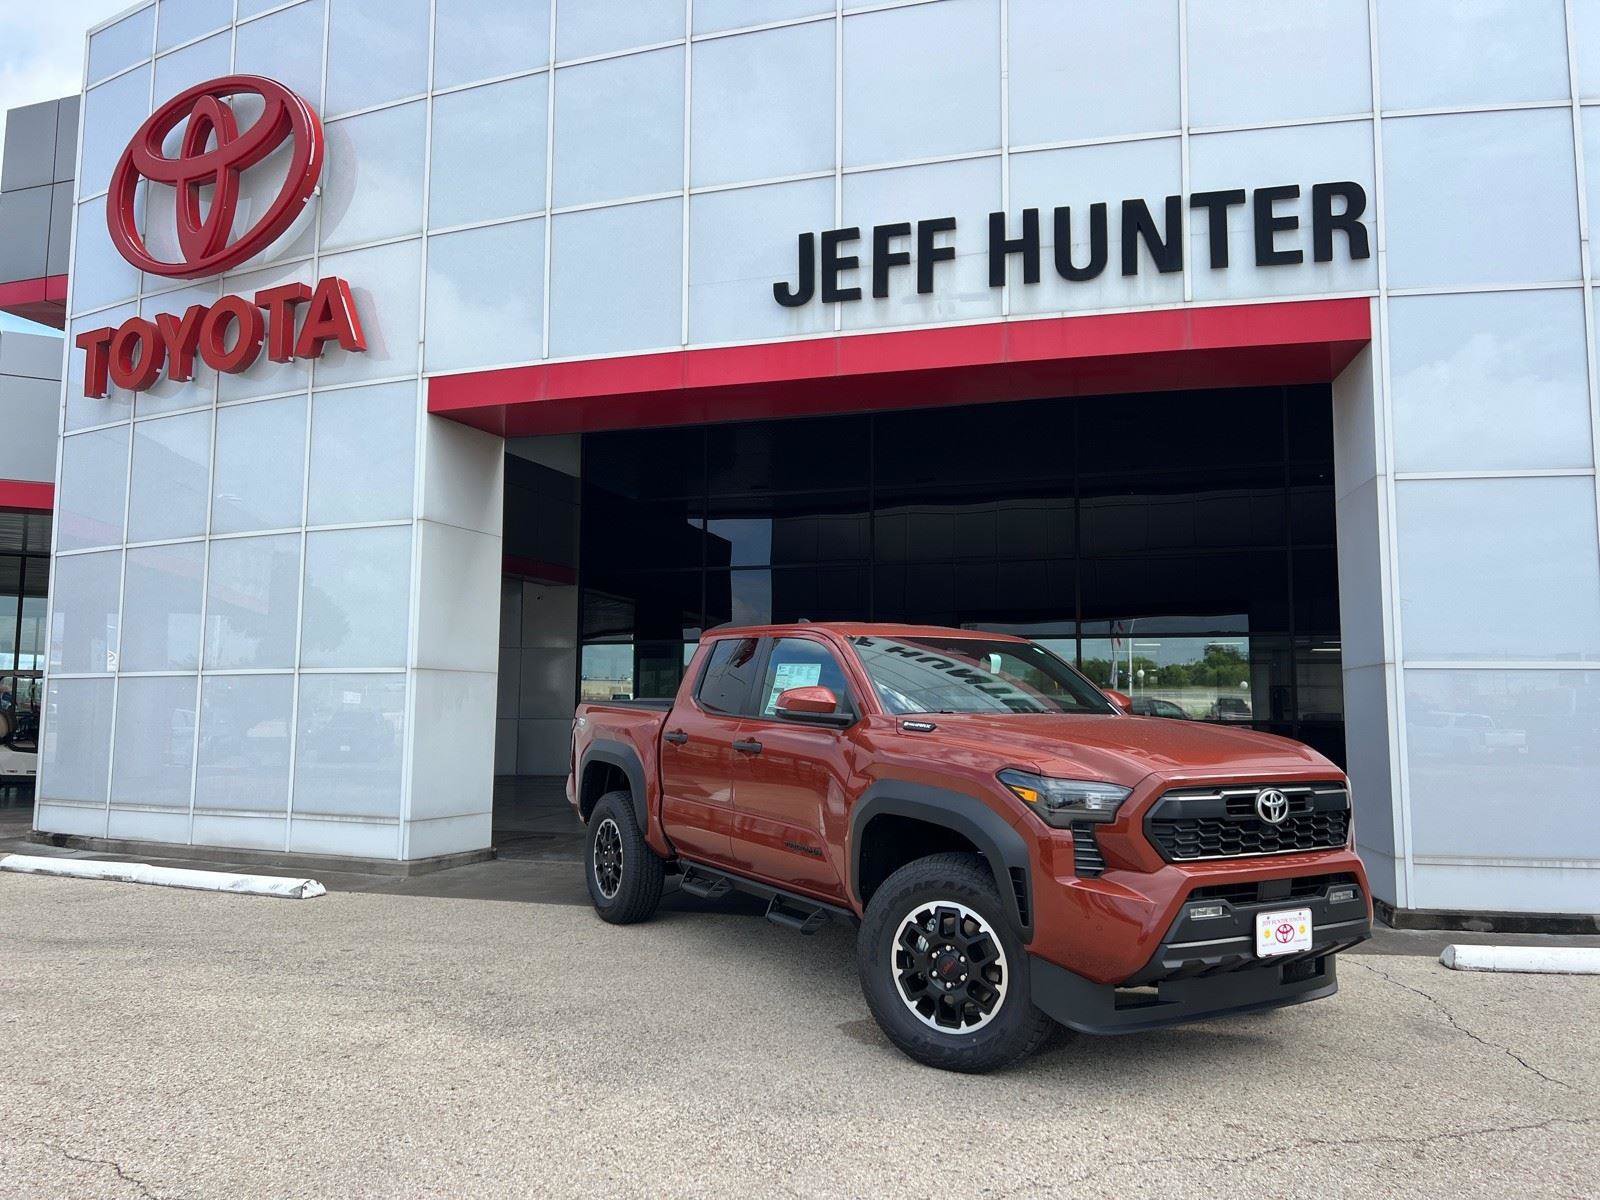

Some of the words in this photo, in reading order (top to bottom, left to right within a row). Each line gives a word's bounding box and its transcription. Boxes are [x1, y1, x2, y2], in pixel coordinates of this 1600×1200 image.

[773, 217, 957, 307] JEFF
[988, 180, 1370, 288] HUNTER
[76, 276, 367, 399] TOYOTA
